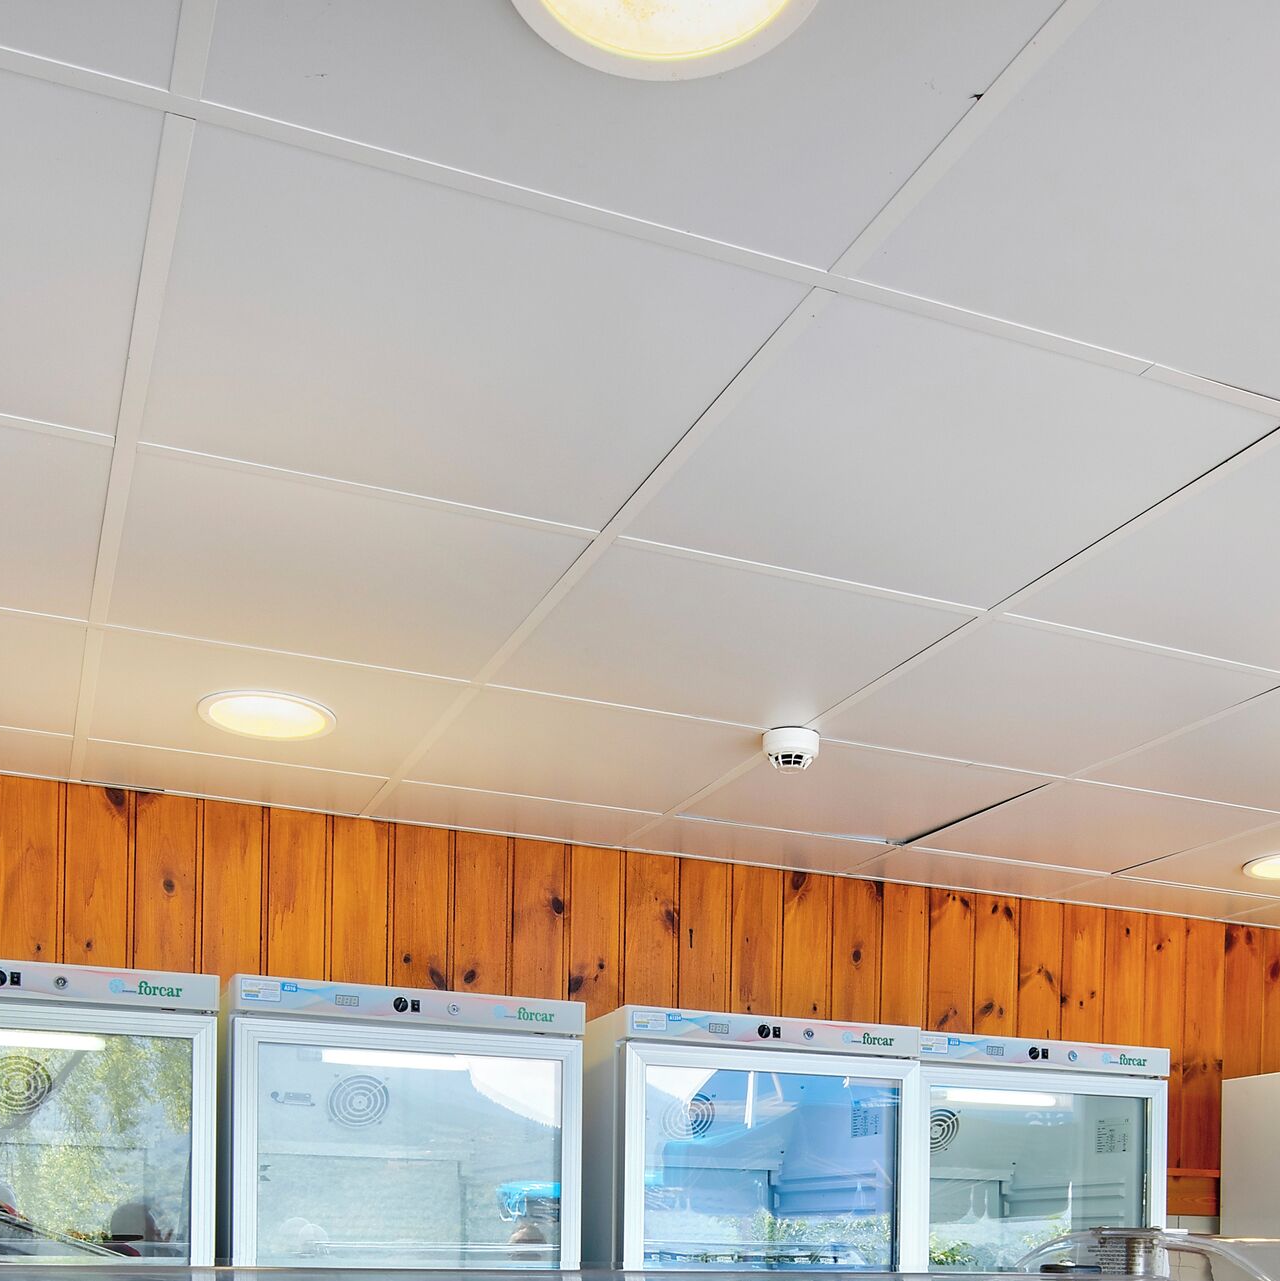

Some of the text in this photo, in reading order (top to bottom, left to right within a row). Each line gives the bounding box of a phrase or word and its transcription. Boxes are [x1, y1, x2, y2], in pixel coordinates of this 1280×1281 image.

[138, 981, 183, 997] forcar
[517, 1007, 554, 1022] forcar
[862, 1032, 894, 1046] forcar
[1120, 1053, 1147, 1066] forcar
